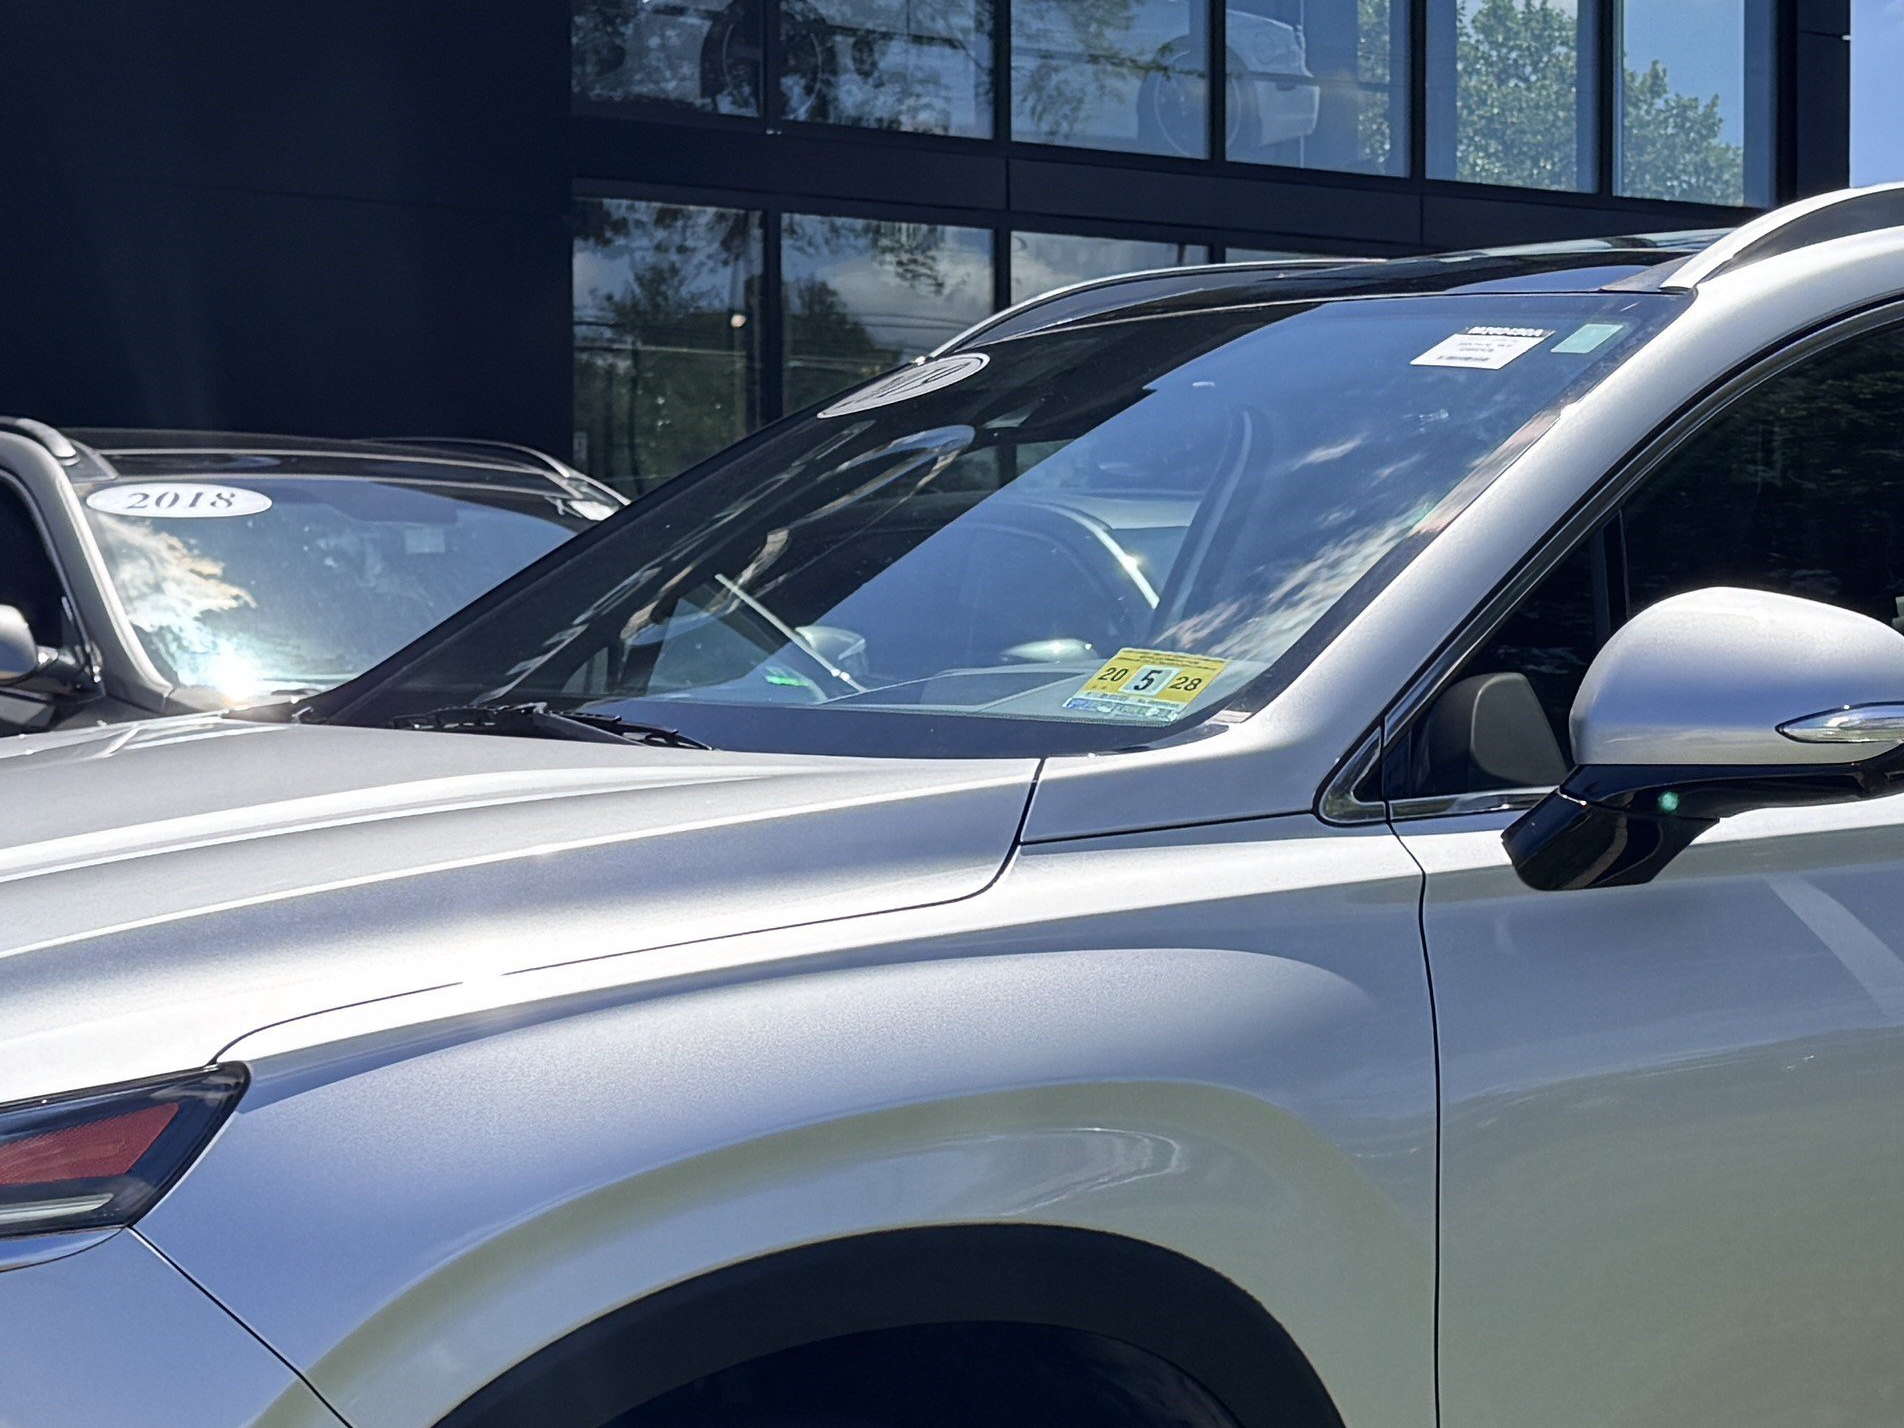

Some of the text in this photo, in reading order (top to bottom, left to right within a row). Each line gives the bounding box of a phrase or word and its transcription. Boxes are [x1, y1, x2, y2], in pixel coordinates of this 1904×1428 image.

[125, 491, 236, 510] 2018
[1097, 667, 1203, 692] 20 5 28
